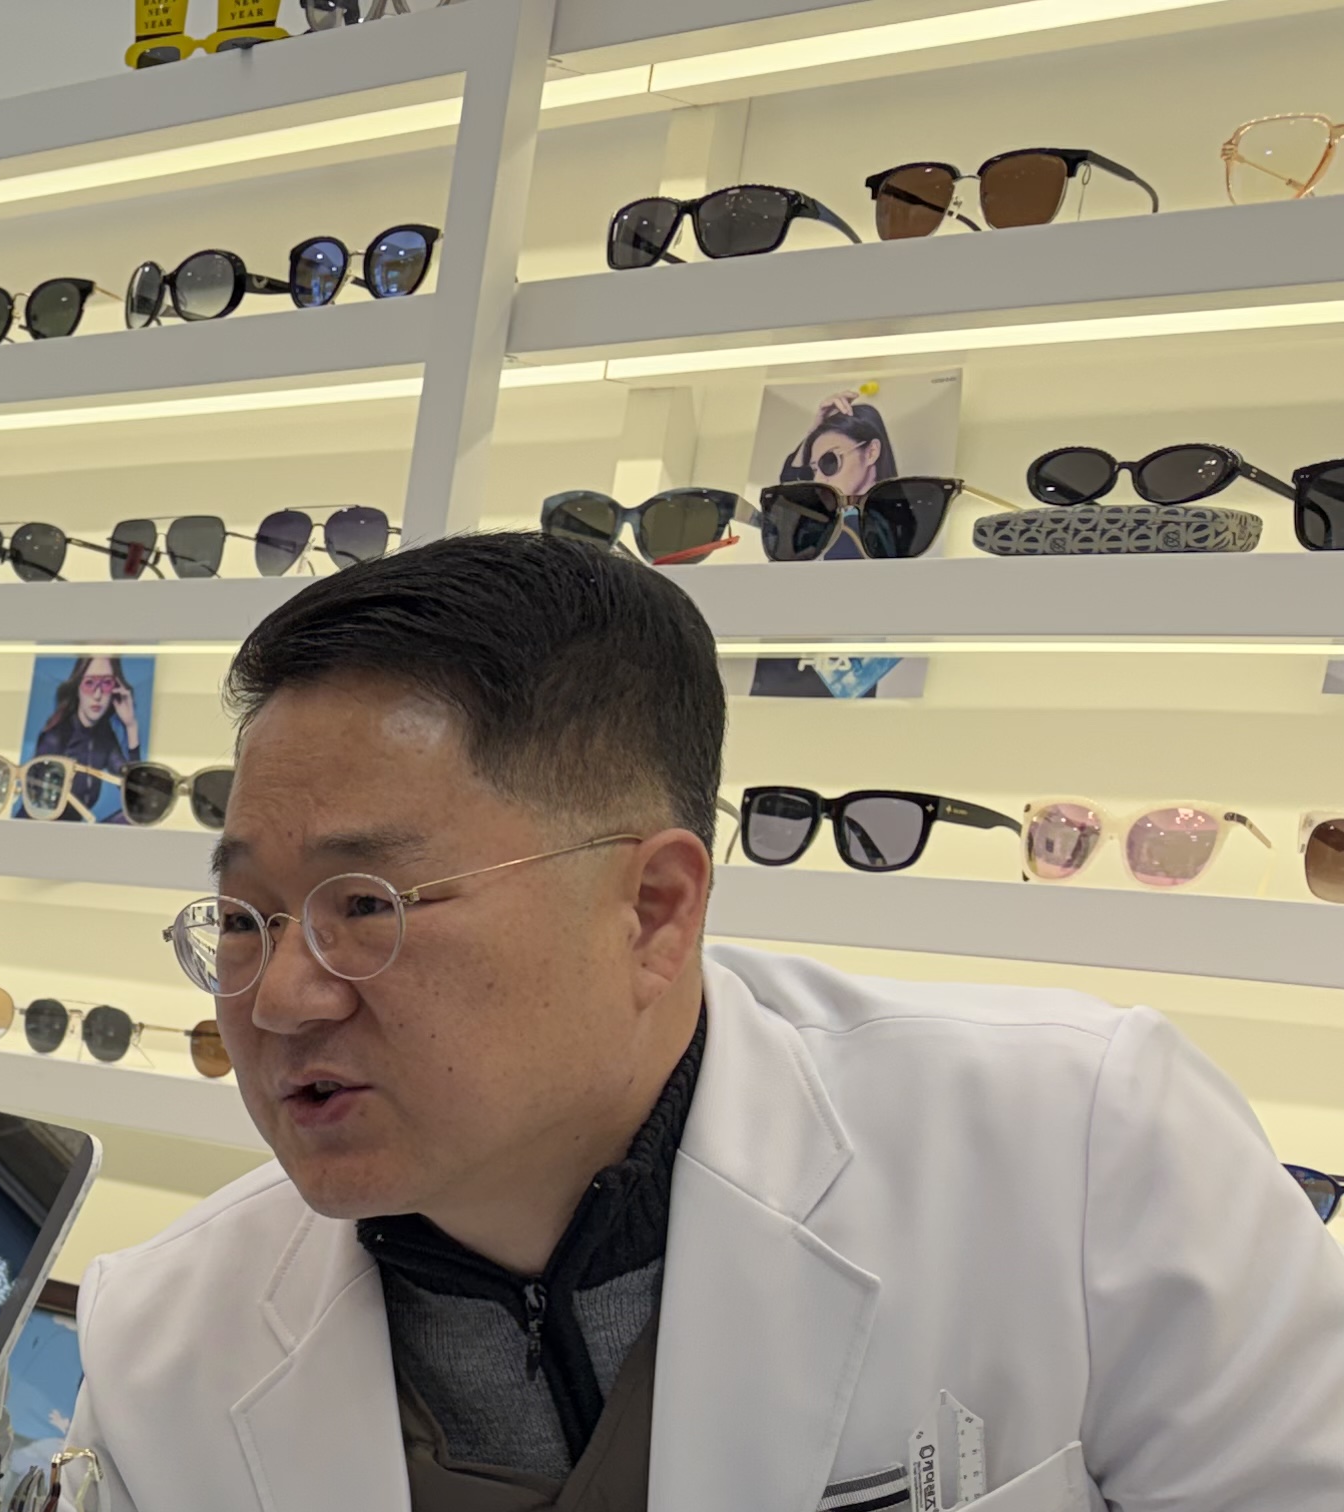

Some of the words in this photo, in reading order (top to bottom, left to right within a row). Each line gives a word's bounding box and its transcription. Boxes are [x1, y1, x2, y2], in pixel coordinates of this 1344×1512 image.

[148, 6, 170, 16] NEW
[230, 8, 265, 21] YEAR
[144, 18, 173, 29] YEAR
